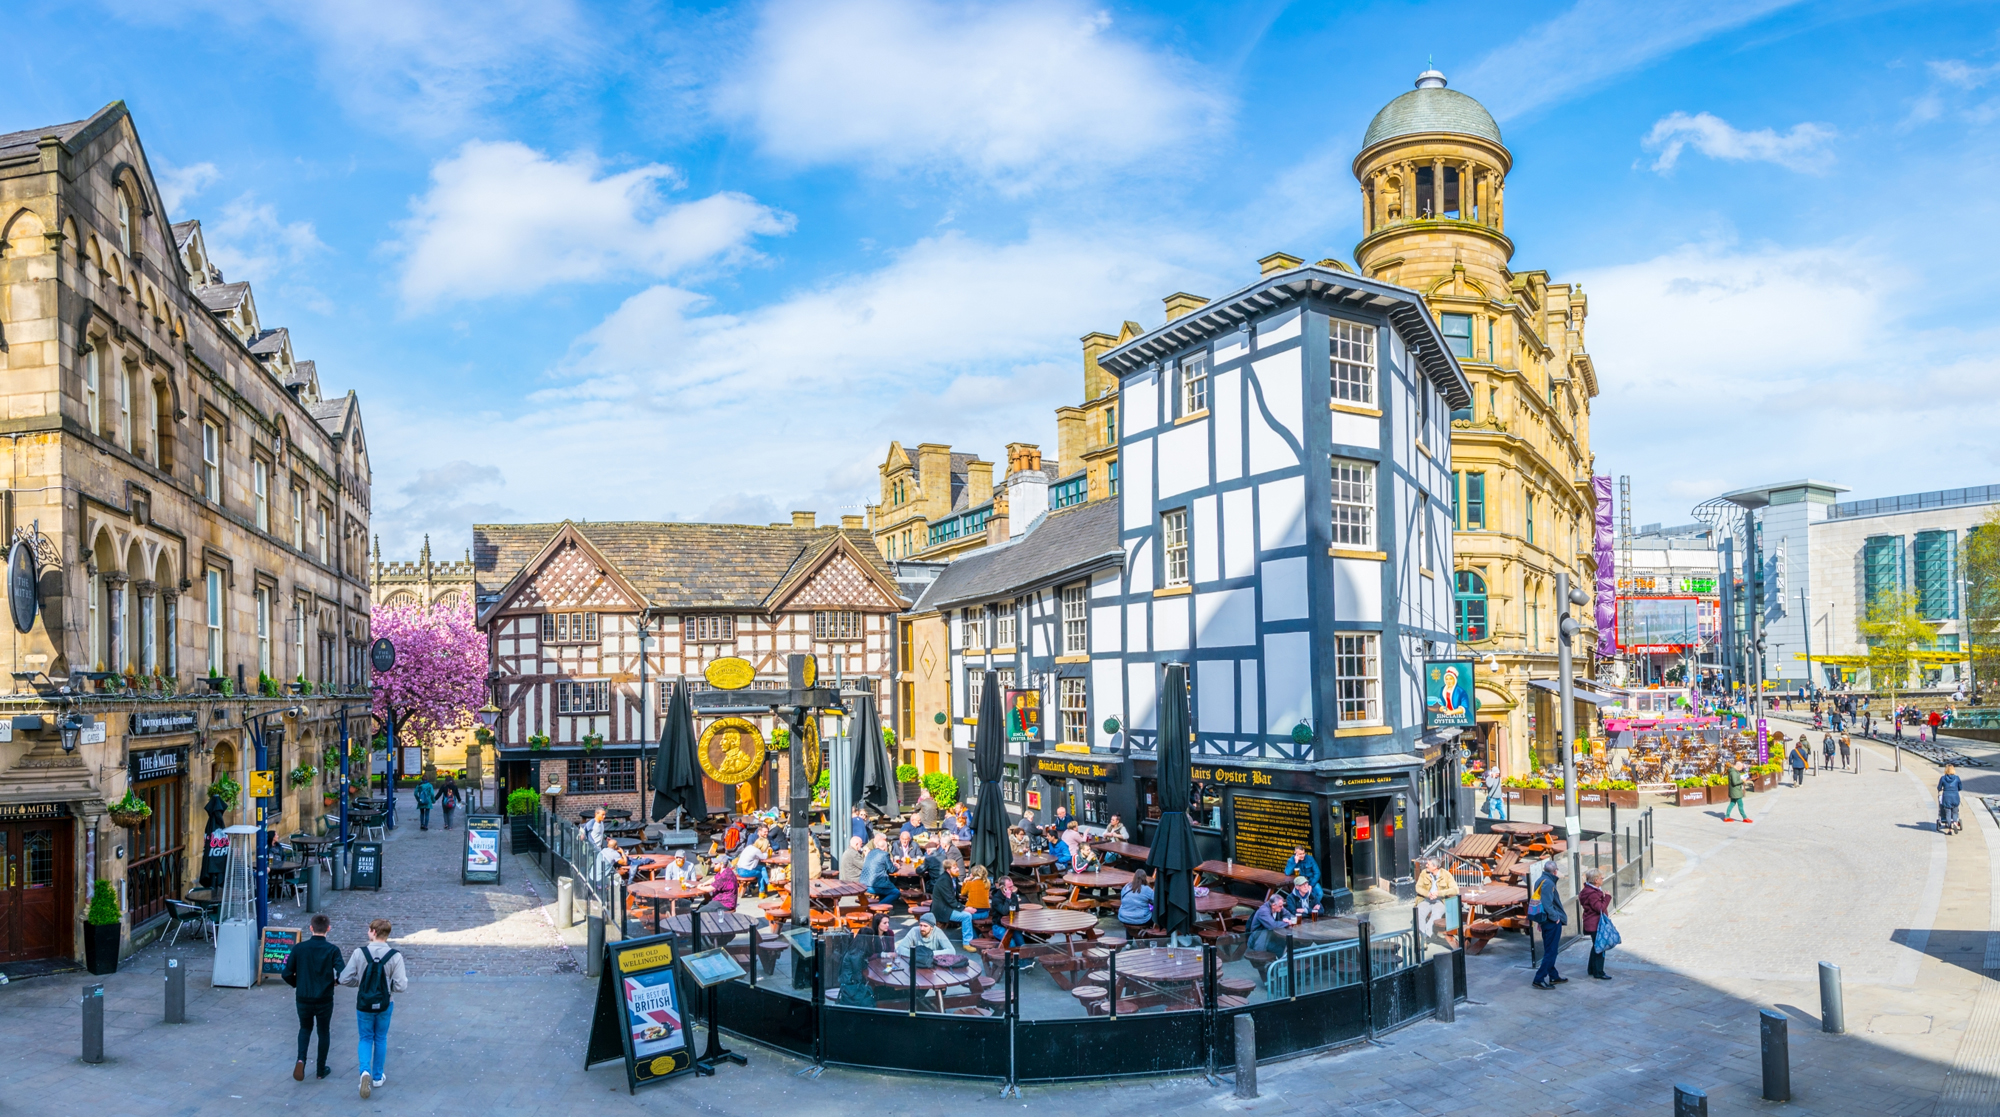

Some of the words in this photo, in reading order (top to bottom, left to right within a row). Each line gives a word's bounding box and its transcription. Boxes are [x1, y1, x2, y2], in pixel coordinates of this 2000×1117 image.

[17, 577, 29, 588] THE
[14, 587, 33, 600] MITRE
[139, 757, 153, 771] THE
[159, 754, 177, 767] MITRE
[1038, 760, 1066, 773] Sinclairs
[1067, 762, 1090, 776] Oyster
[1092, 764, 1107, 777] Bar
[1215, 768, 1247, 784] Oyster
[1252, 770, 1272, 786] Bar
[27, 804, 58, 813] MITRE
[623, 954, 669, 968] WELLINGTON
[634, 994, 644, 1002] THE
[646, 990, 660, 1000] BEST
[661, 988, 668, 997] OF
[634, 996, 670, 1012] BRITISH
